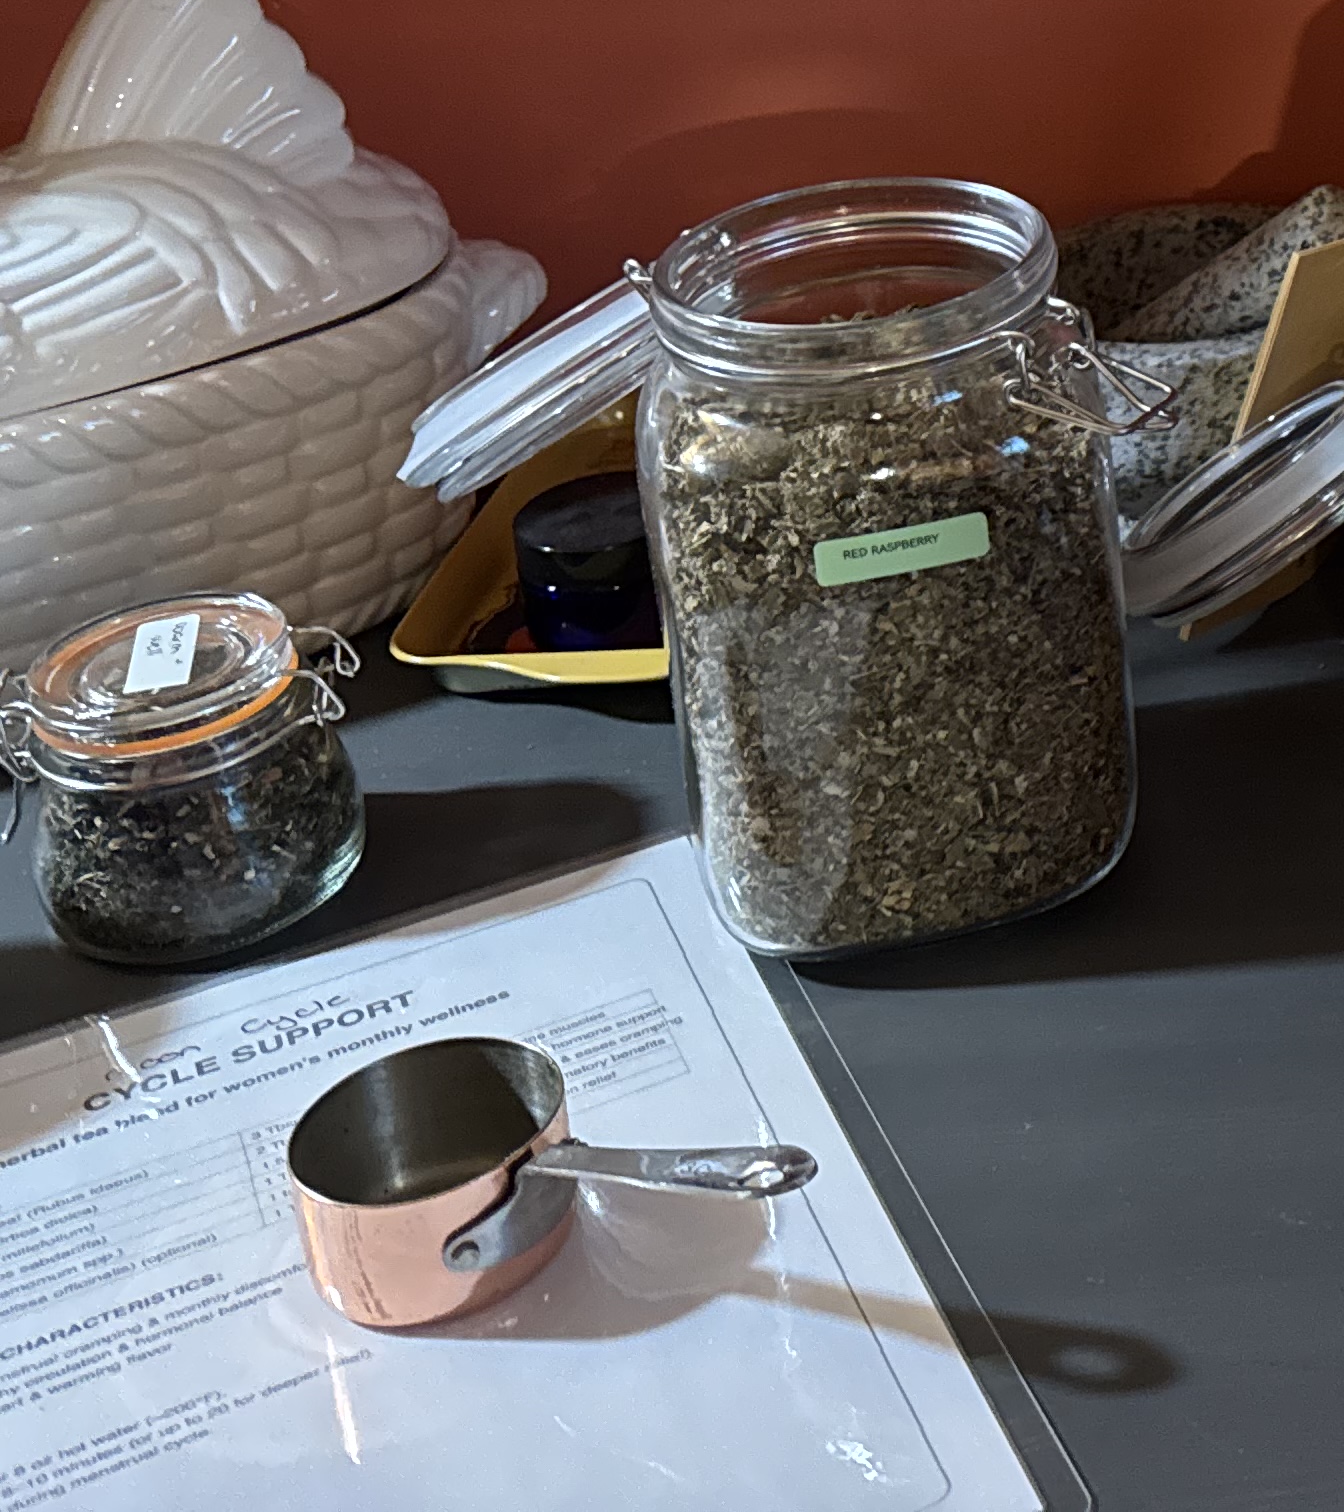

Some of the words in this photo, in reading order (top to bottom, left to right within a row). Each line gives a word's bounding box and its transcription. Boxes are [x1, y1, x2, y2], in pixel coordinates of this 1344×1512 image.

[843, 549, 868, 561] RED
[871, 532, 940, 556] RASPBERRY
[549, 1011, 606, 1036] muscles
[551, 1024, 613, 1051] hormone
[616, 1005, 667, 1029] support
[575, 1039, 618, 1059] eases
[619, 1015, 684, 1044] cramping
[84, 1055, 221, 1111] CYCLE
[231, 990, 413, 1064] SUPPORT
[610, 1037, 667, 1063] benefits
[73, 1126, 108, 1144] tea
[185, 1090, 217, 1108] for
[223, 1056, 321, 1093] women's
[327, 1022, 413, 1059] monthly
[418, 990, 510, 1027] wellness
[582, 1070, 618, 1089] relief
[234, 1263, 306, 1295] discomfo
